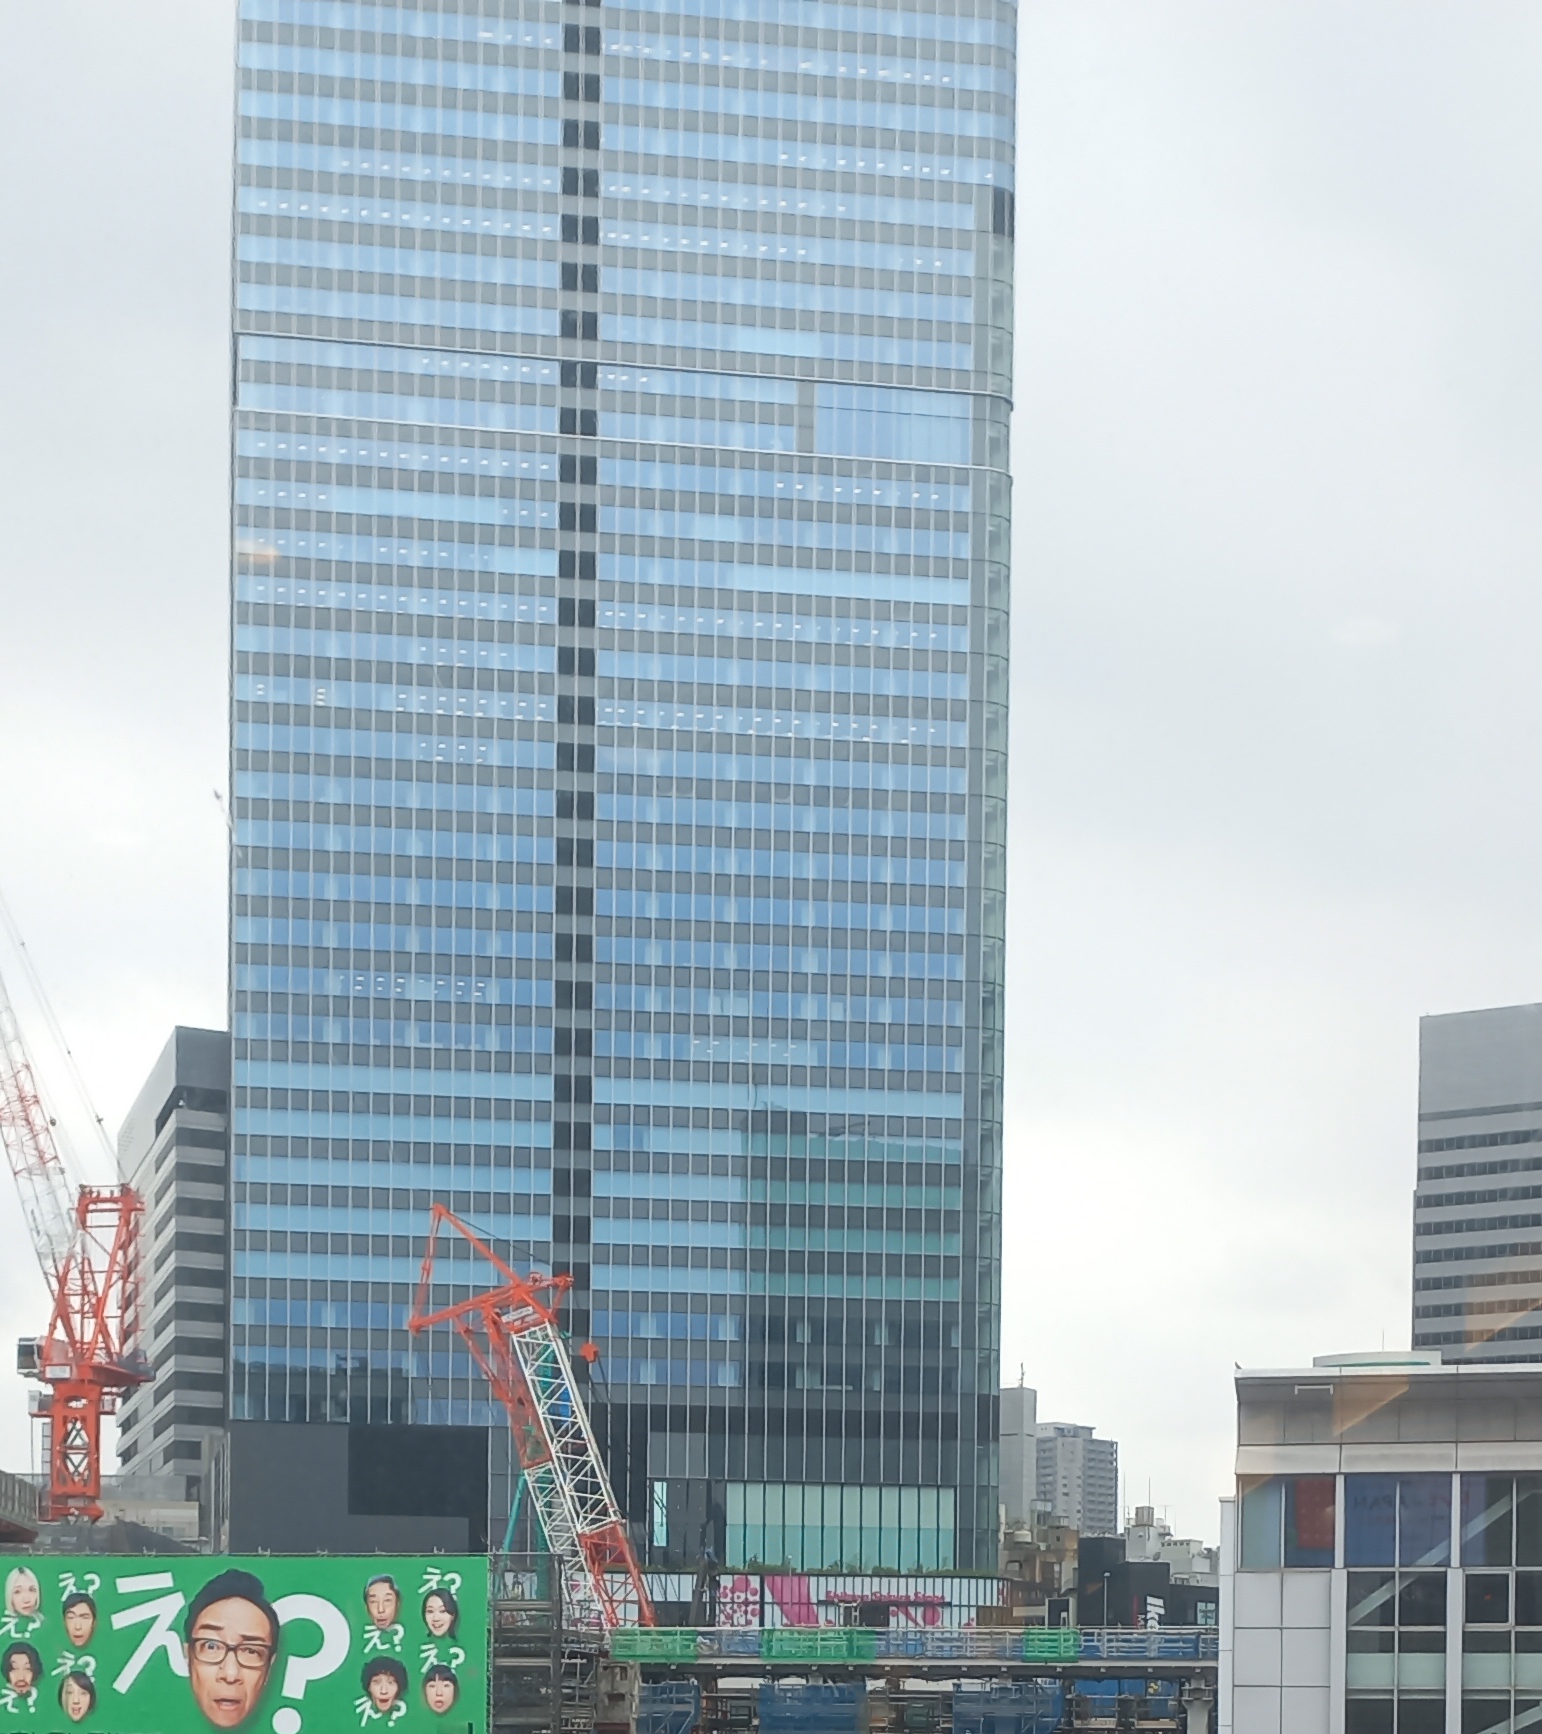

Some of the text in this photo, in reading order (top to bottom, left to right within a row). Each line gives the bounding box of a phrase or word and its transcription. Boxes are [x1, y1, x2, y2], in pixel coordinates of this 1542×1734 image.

[58, 1572, 101, 1602] え?
[418, 1567, 462, 1598] え?
[363, 1624, 404, 1654] え?
[419, 1644, 466, 1675] え?
